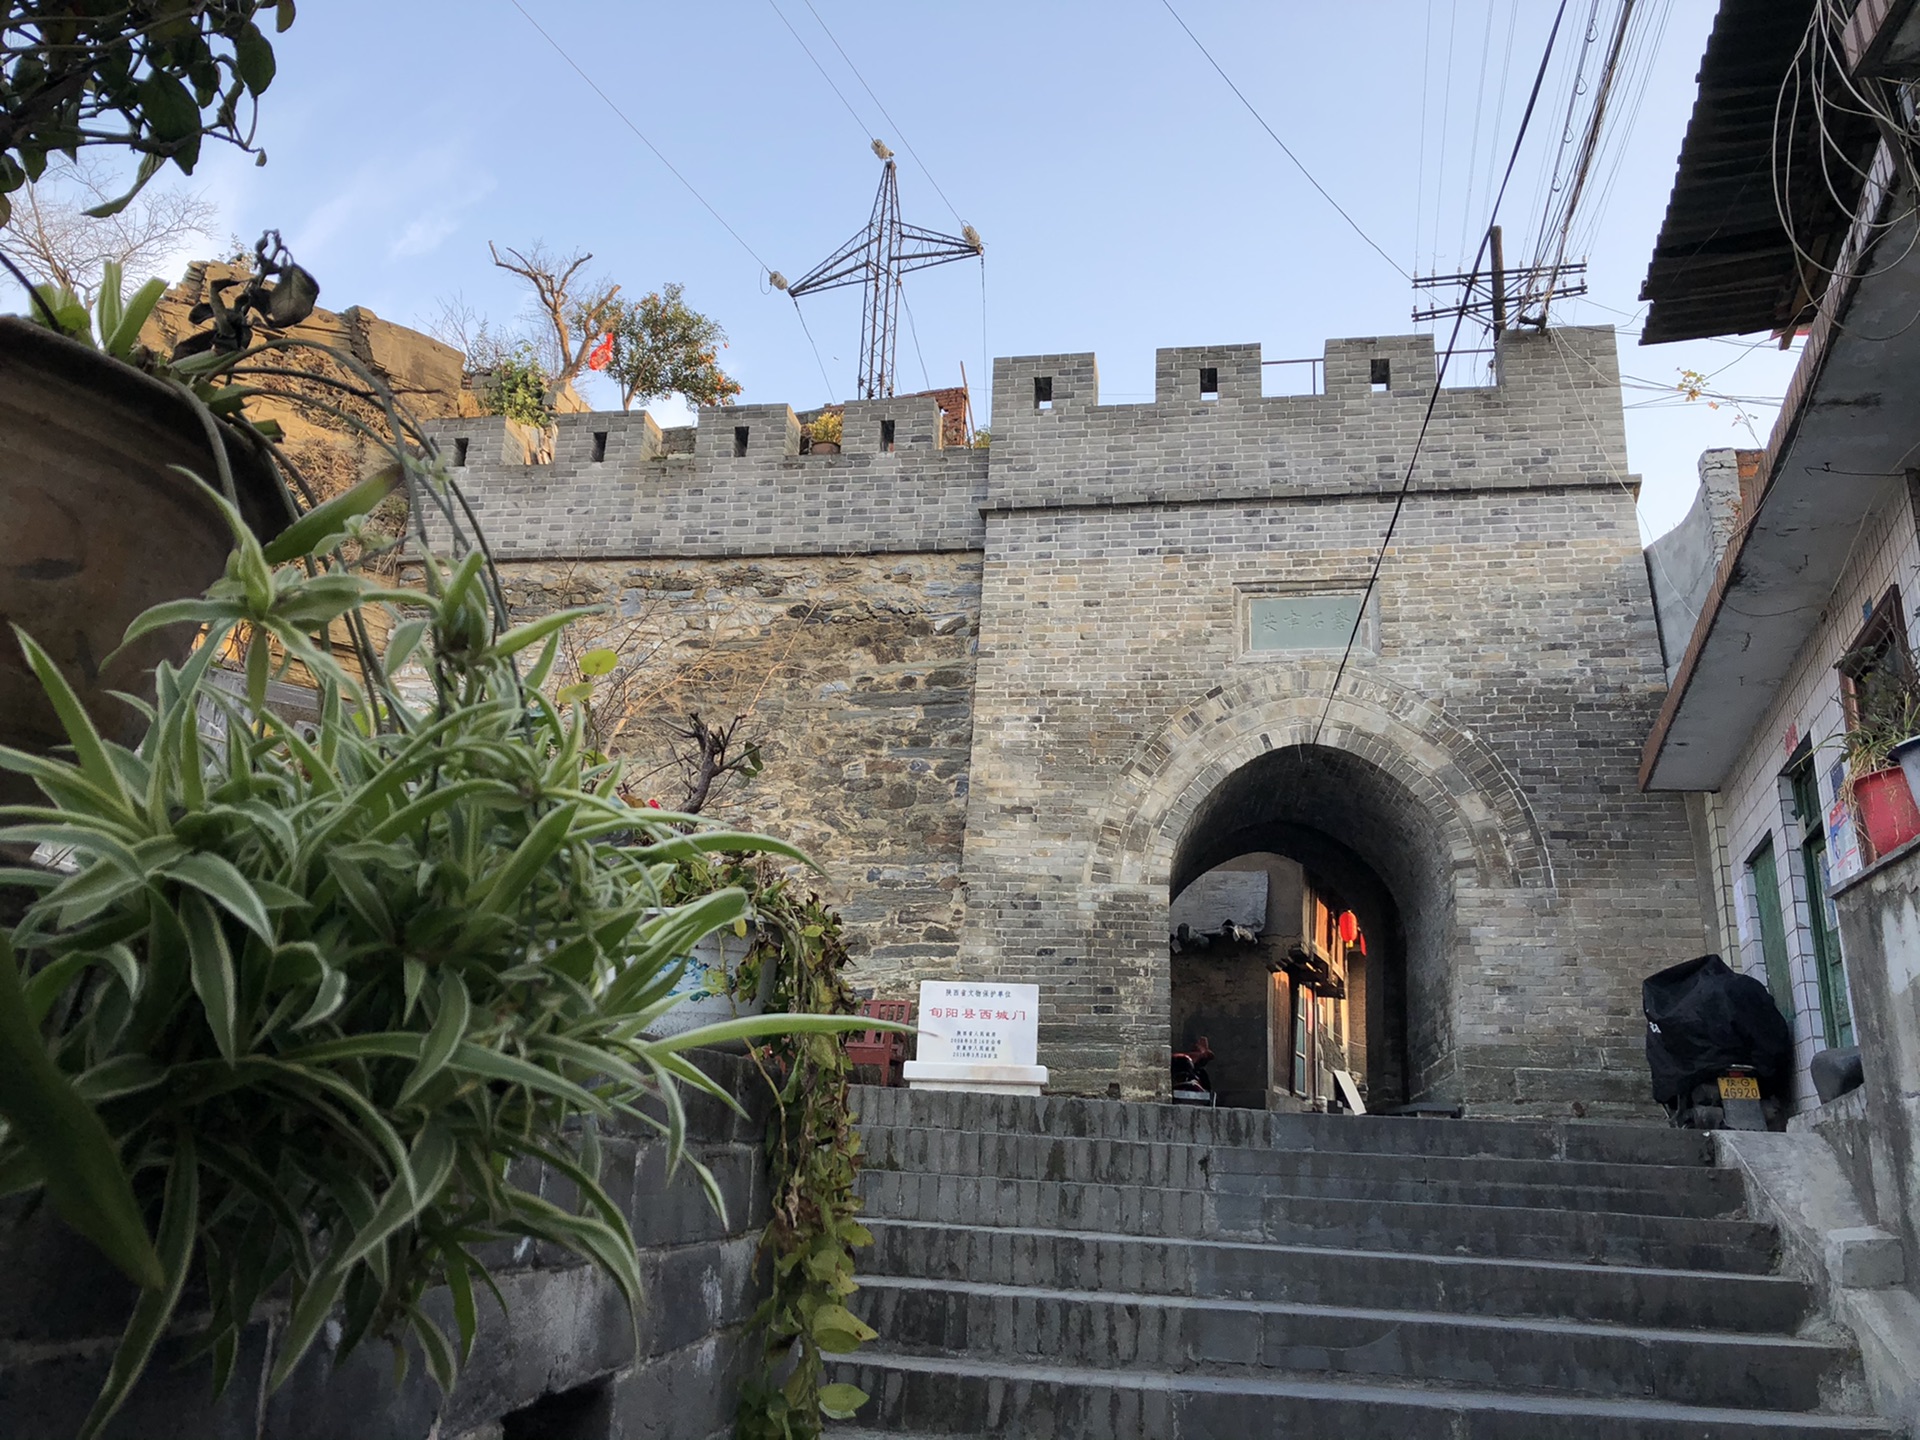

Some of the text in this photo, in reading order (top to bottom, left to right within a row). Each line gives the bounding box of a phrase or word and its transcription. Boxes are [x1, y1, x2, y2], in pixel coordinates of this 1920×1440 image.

[945, 989, 1012, 998] 陕西省文物保护单位
[929, 1007, 1026, 1021] 旬阳县西城门
